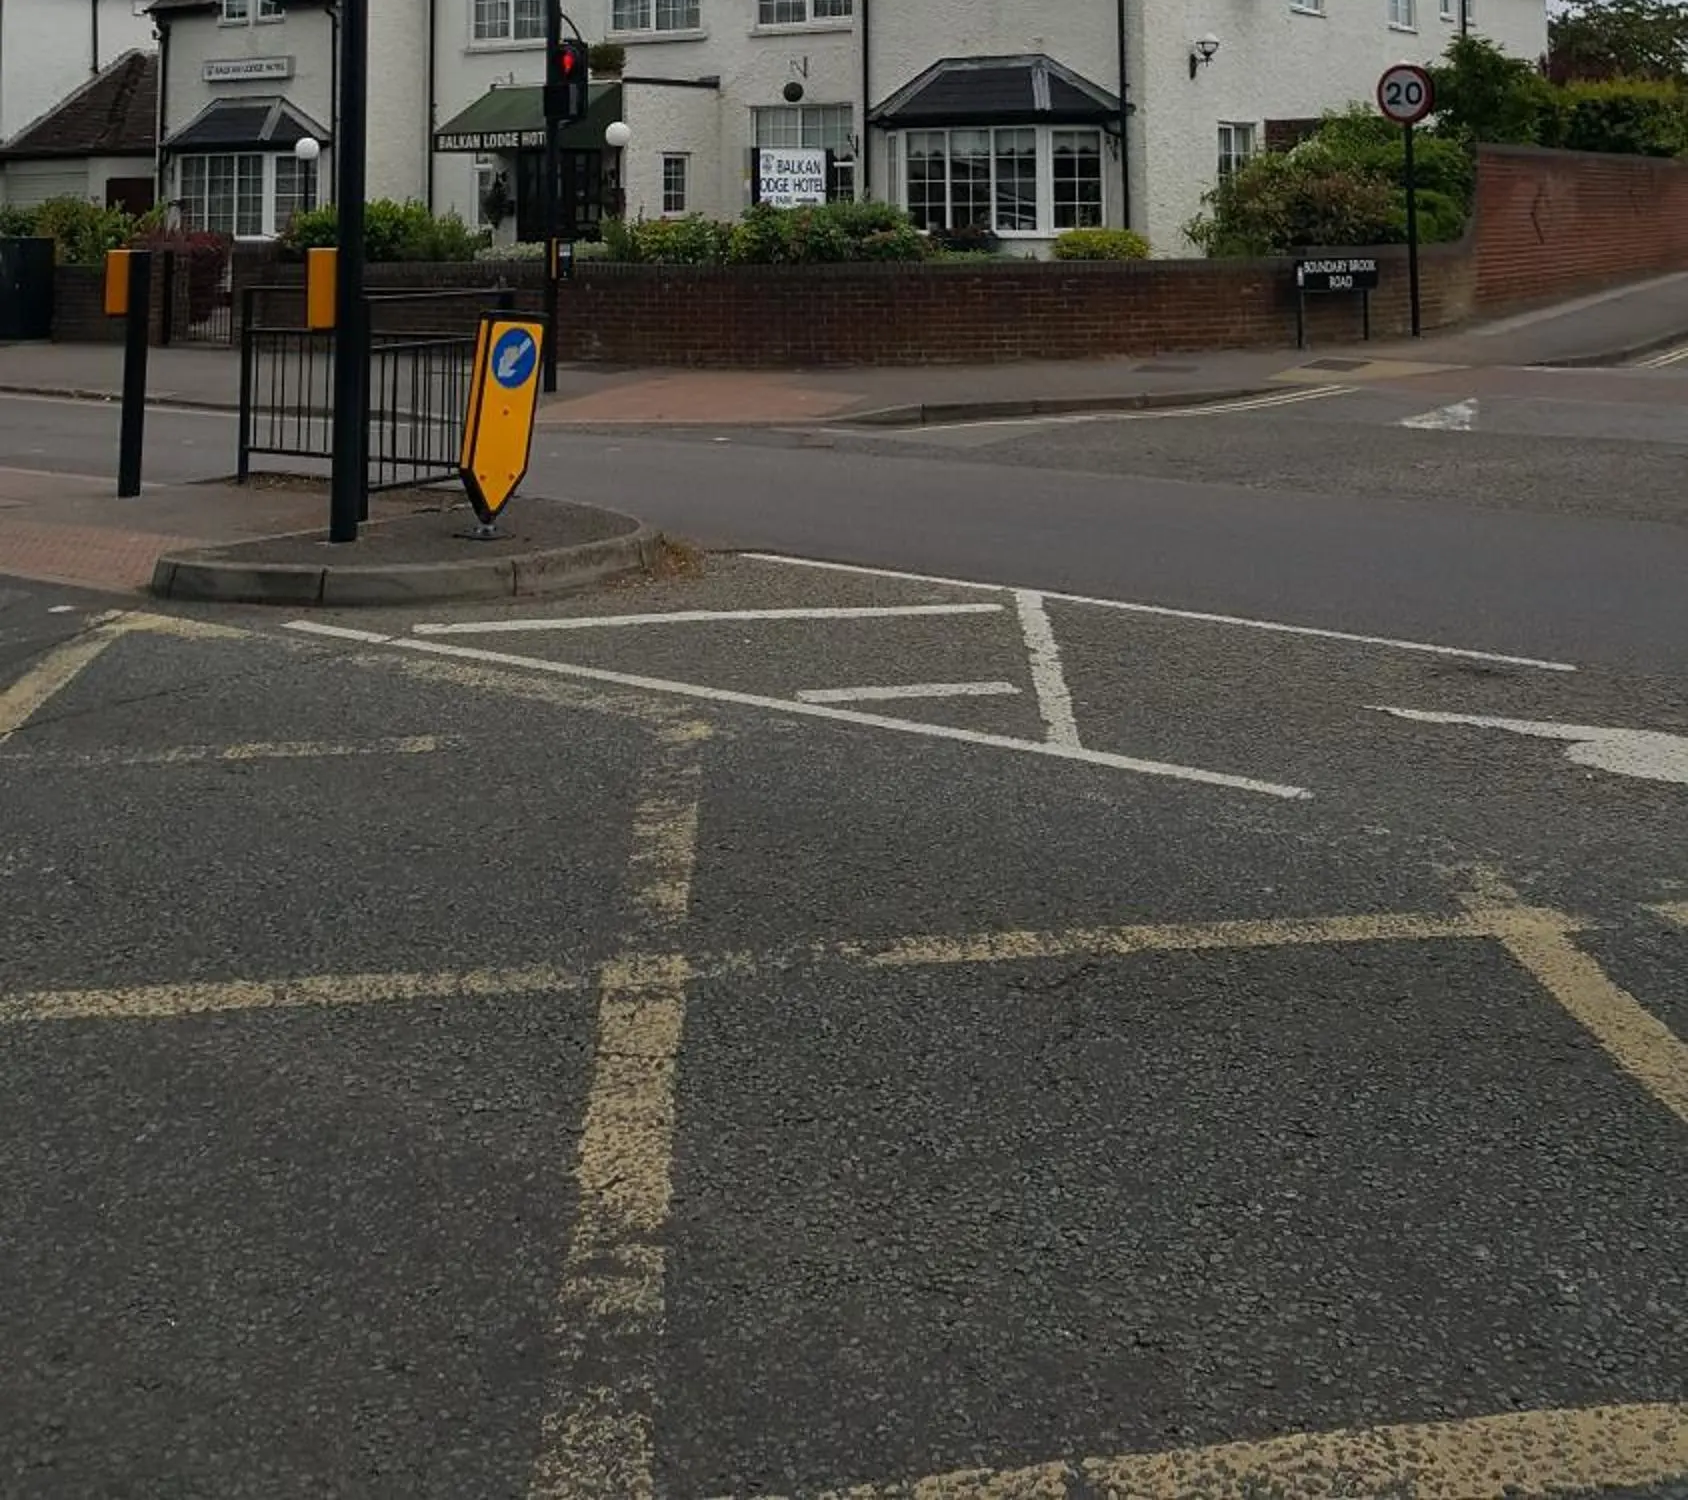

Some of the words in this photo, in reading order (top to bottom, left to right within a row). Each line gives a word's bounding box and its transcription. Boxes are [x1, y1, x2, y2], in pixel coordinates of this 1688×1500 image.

[1386, 81, 1422, 105] 20
[438, 134, 481, 149] BALKAN
[483, 132, 519, 147] LODGE
[521, 131, 547, 147] HOT
[777, 159, 821, 174] BALKAN
[760, 177, 790, 192] ODGE
[794, 177, 826, 192] HOTEL
[1303, 260, 1347, 273] BOUNDARY
[1329, 275, 1353, 289] ROAD
